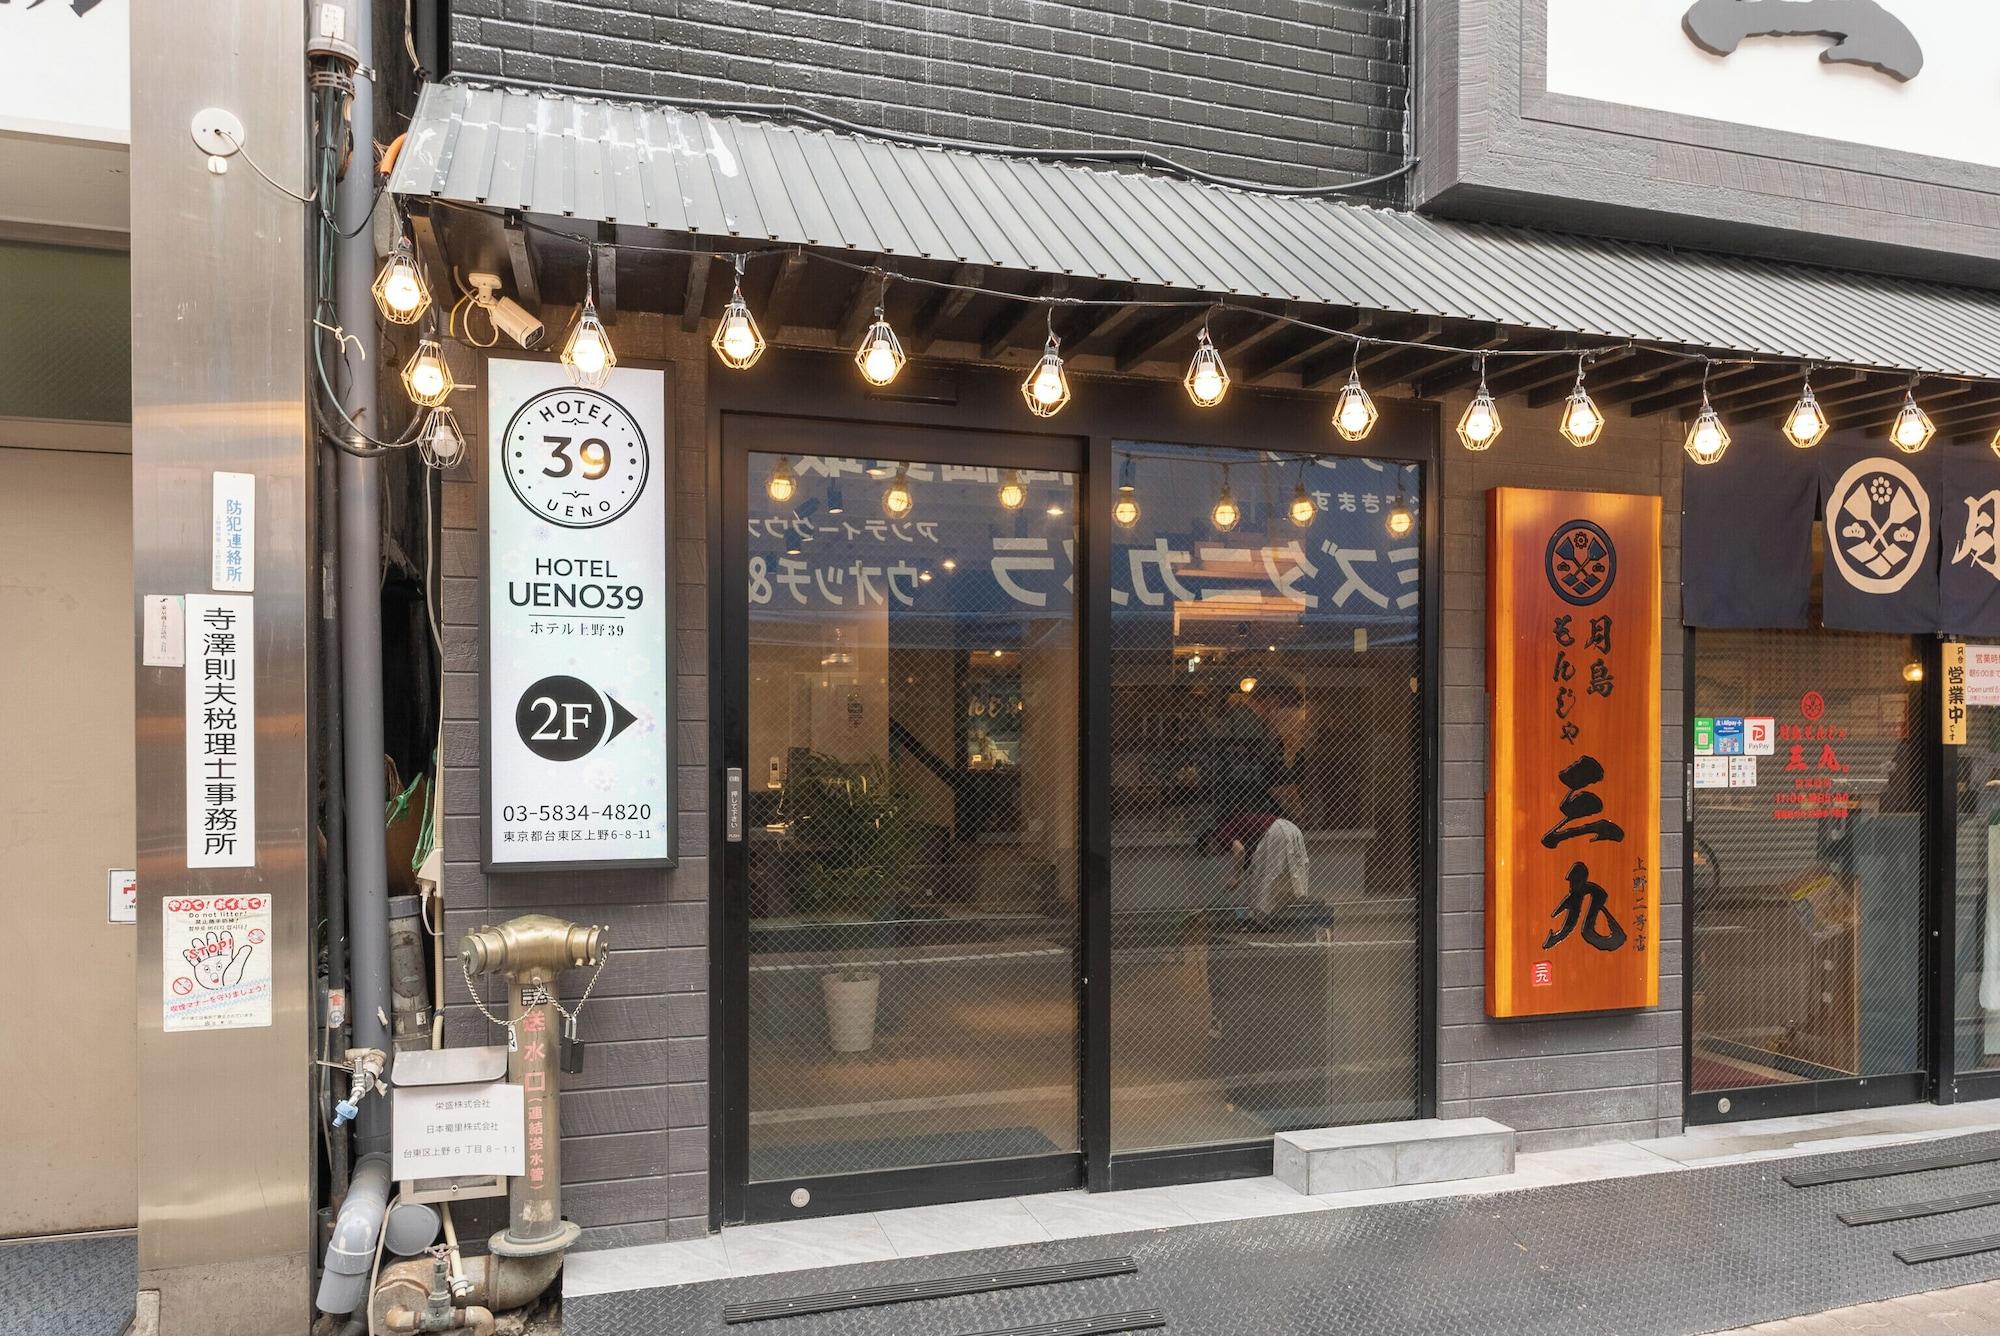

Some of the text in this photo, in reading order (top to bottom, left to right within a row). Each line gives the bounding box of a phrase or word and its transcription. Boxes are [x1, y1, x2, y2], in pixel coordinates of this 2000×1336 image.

[539, 400, 615, 427] HOTEL
[542, 435, 611, 480] 39
[547, 499, 611, 517] UENO
[225, 499, 243, 582] 防犯連絡所
[535, 558, 618, 578] HOTEL
[509, 582, 644, 610] UENO39
[530, 622, 624, 637] ホテル上野39
[1584, 614, 1614, 697] 月島
[1553, 614, 1579, 744] もんじゃ
[203, 607, 238, 855] 寺澤則夫税理士事務所
[530, 697, 592, 740] 2F
[503, 804, 651, 822] 03-5834-4820
[503, 829, 652, 842] 東京都台東区上野6-8-11
[189, 938, 232, 959] STOP!
[435, 1099, 491, 1112] 栄盛株式会社
